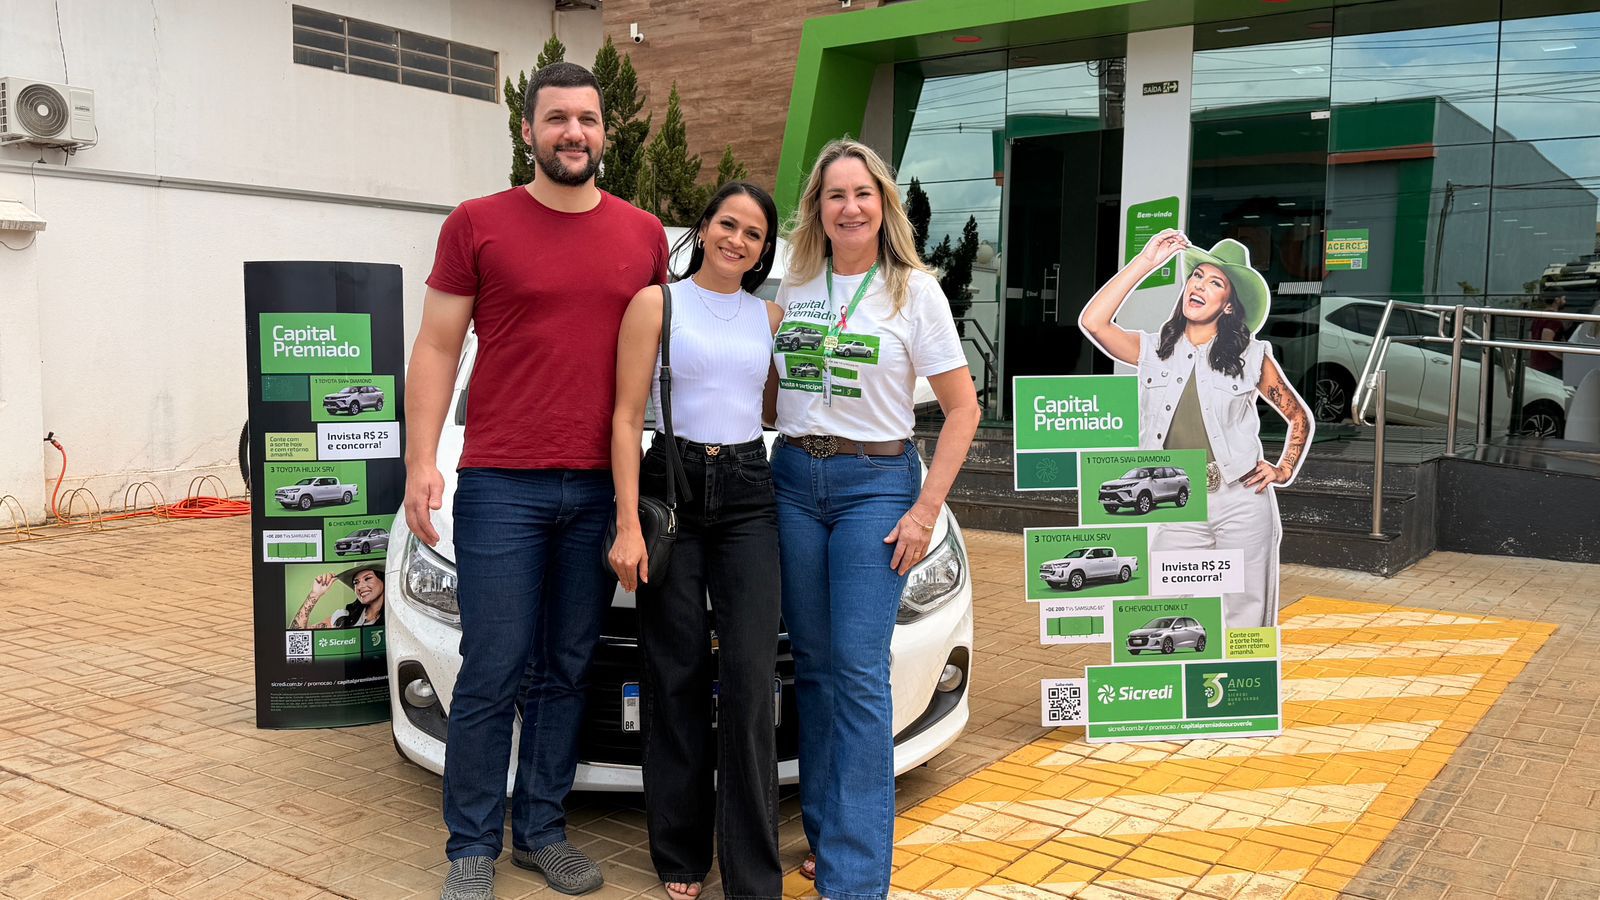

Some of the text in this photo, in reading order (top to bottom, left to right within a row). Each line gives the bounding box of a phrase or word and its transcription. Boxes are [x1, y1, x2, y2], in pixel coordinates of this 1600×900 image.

[788, 300, 826, 310] Capital
[786, 309, 836, 320] Premiado
[272, 325, 337, 344] Capital
[273, 341, 360, 357] Premiado
[1034, 395, 1099, 417] Capital
[1034, 412, 1123, 431] Premiado
[327, 432, 361, 440] Invista
[363, 431, 375, 440] R$
[336, 441, 382, 450] concorra!
[1162, 560, 1230, 571] Invista R$ 25
[1171, 572, 1222, 582] concorra!
[329, 638, 356, 646] Sicredi
[1228, 678, 1261, 688] ANOS
[1119, 685, 1173, 700] Sicredi
[626, 721, 634, 730] BR
